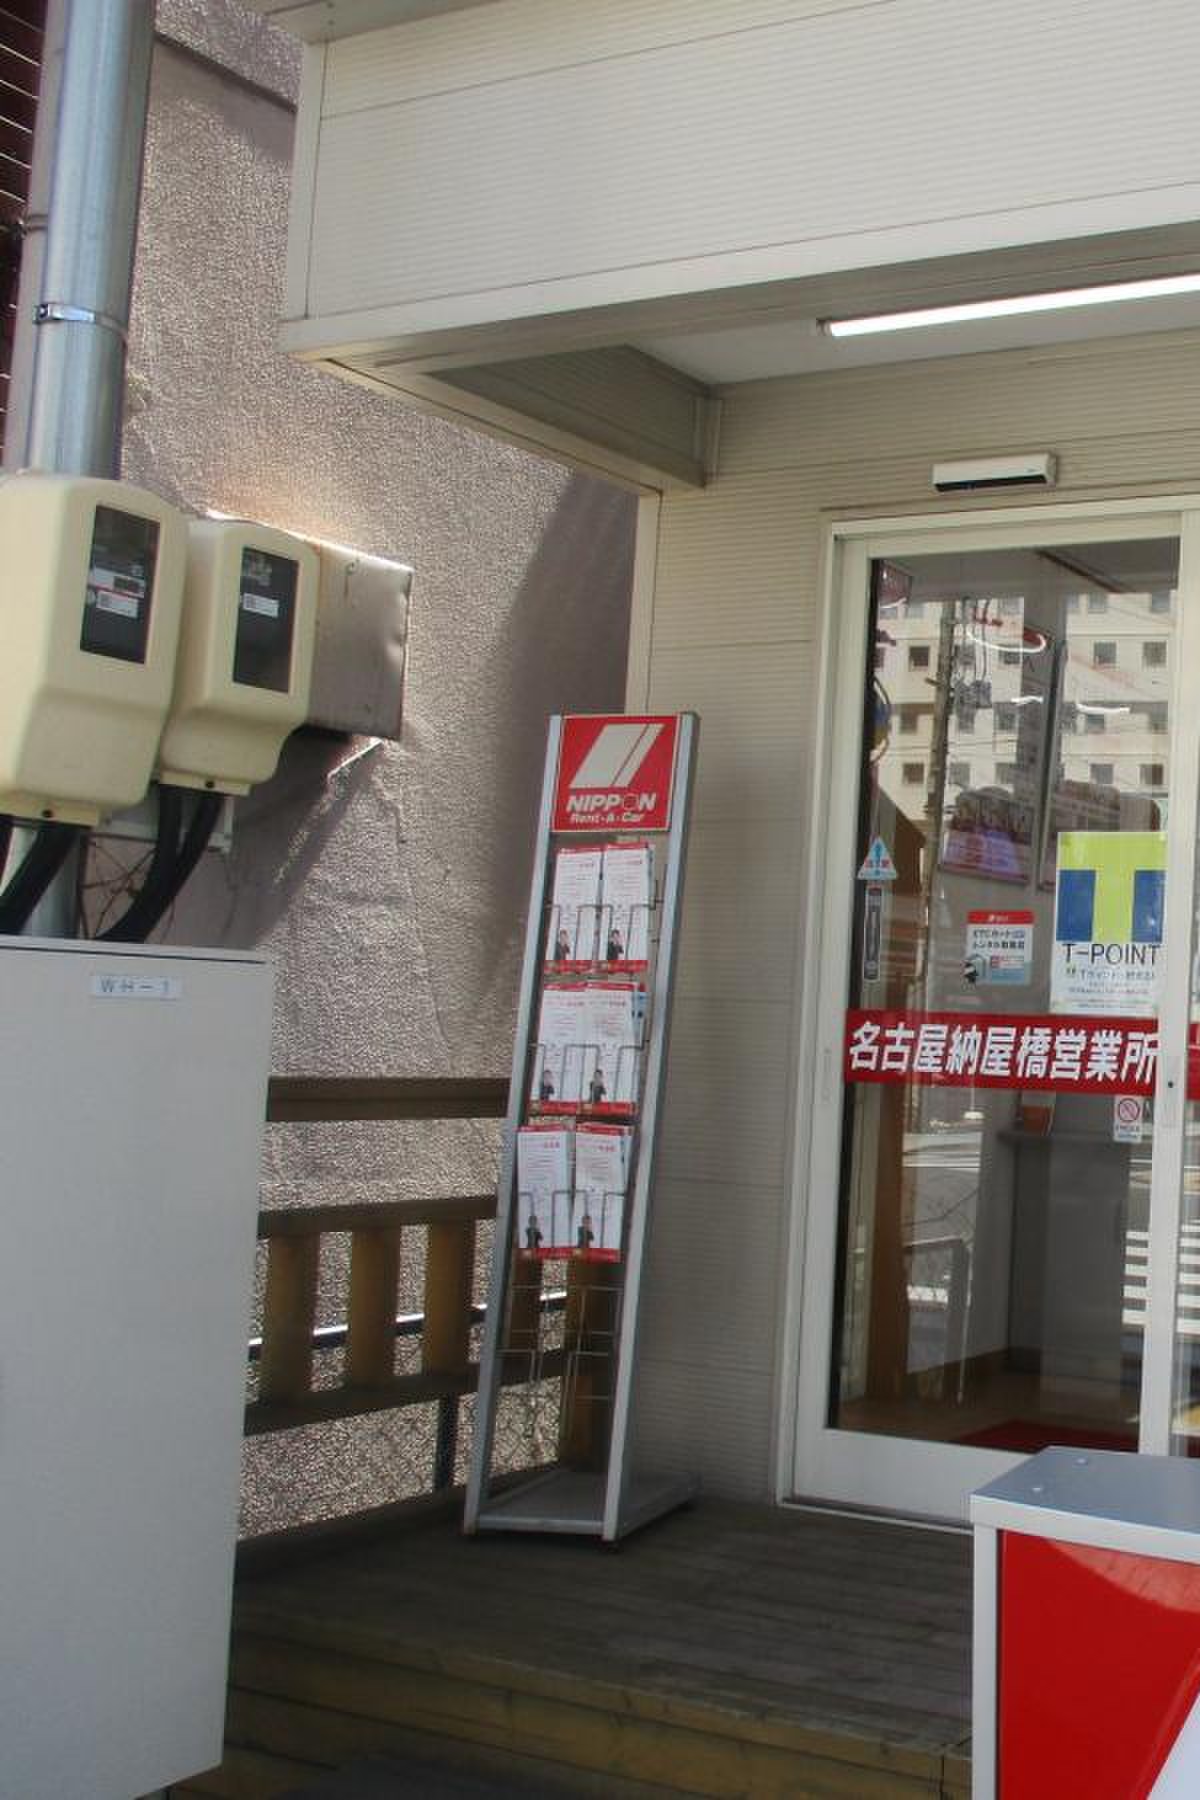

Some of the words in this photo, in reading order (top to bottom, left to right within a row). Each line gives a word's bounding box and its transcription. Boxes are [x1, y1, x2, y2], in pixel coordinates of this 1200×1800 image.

[566, 791, 657, 812] NIPPON
[1063, 943, 1161, 967] T-POINT
[849, 1020, 1159, 1084] 名古屋納屋橋営業所
